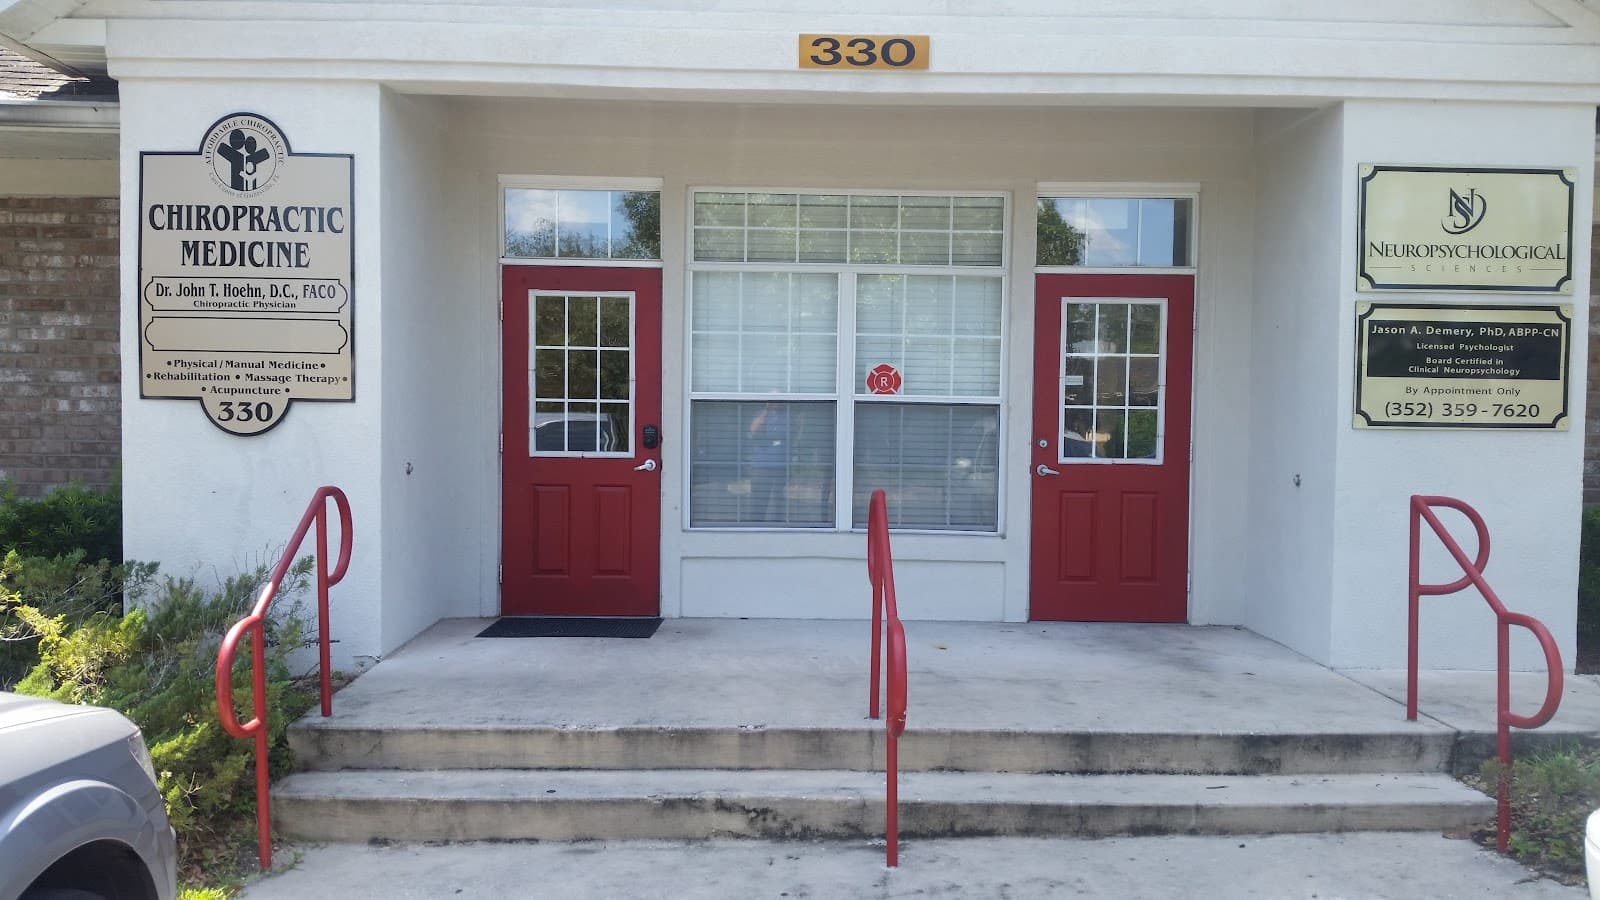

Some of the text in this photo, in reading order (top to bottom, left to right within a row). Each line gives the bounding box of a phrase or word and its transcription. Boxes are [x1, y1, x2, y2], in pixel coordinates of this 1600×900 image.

[811, 37, 915, 66] 330
[205, 119, 284, 166] AFFORDABLE CHIROPRACTIC
[149, 204, 344, 233] CHIROPRACTIC
[181, 240, 310, 268] MEDICINE
[1369, 241, 1565, 260] NEUROPSYCHOLOGICAL
[1411, 265, 1522, 273] SCIENCES
[156, 283, 336, 300] Dr. John T. Hoehn, D.C., FACO
[193, 300, 296, 309] Chiropractic Physician
[1372, 325, 1559, 338] Jason A. Demery, PhD, ABPP-CN
[1460, 344, 1514, 352] Psychologist
[269, 361, 318, 370] Medicine
[1444, 367, 1520, 376] Neuropsychology
[154, 372, 340, 385] Rehabilitation Massage Therapy
[881, 377, 888, 386] R
[210, 386, 281, 395] Acupuncture
[1406, 386, 1520, 396] By Appointment Only
[218, 402, 273, 422] 330
[1385, 401, 1433, 418] (352)
